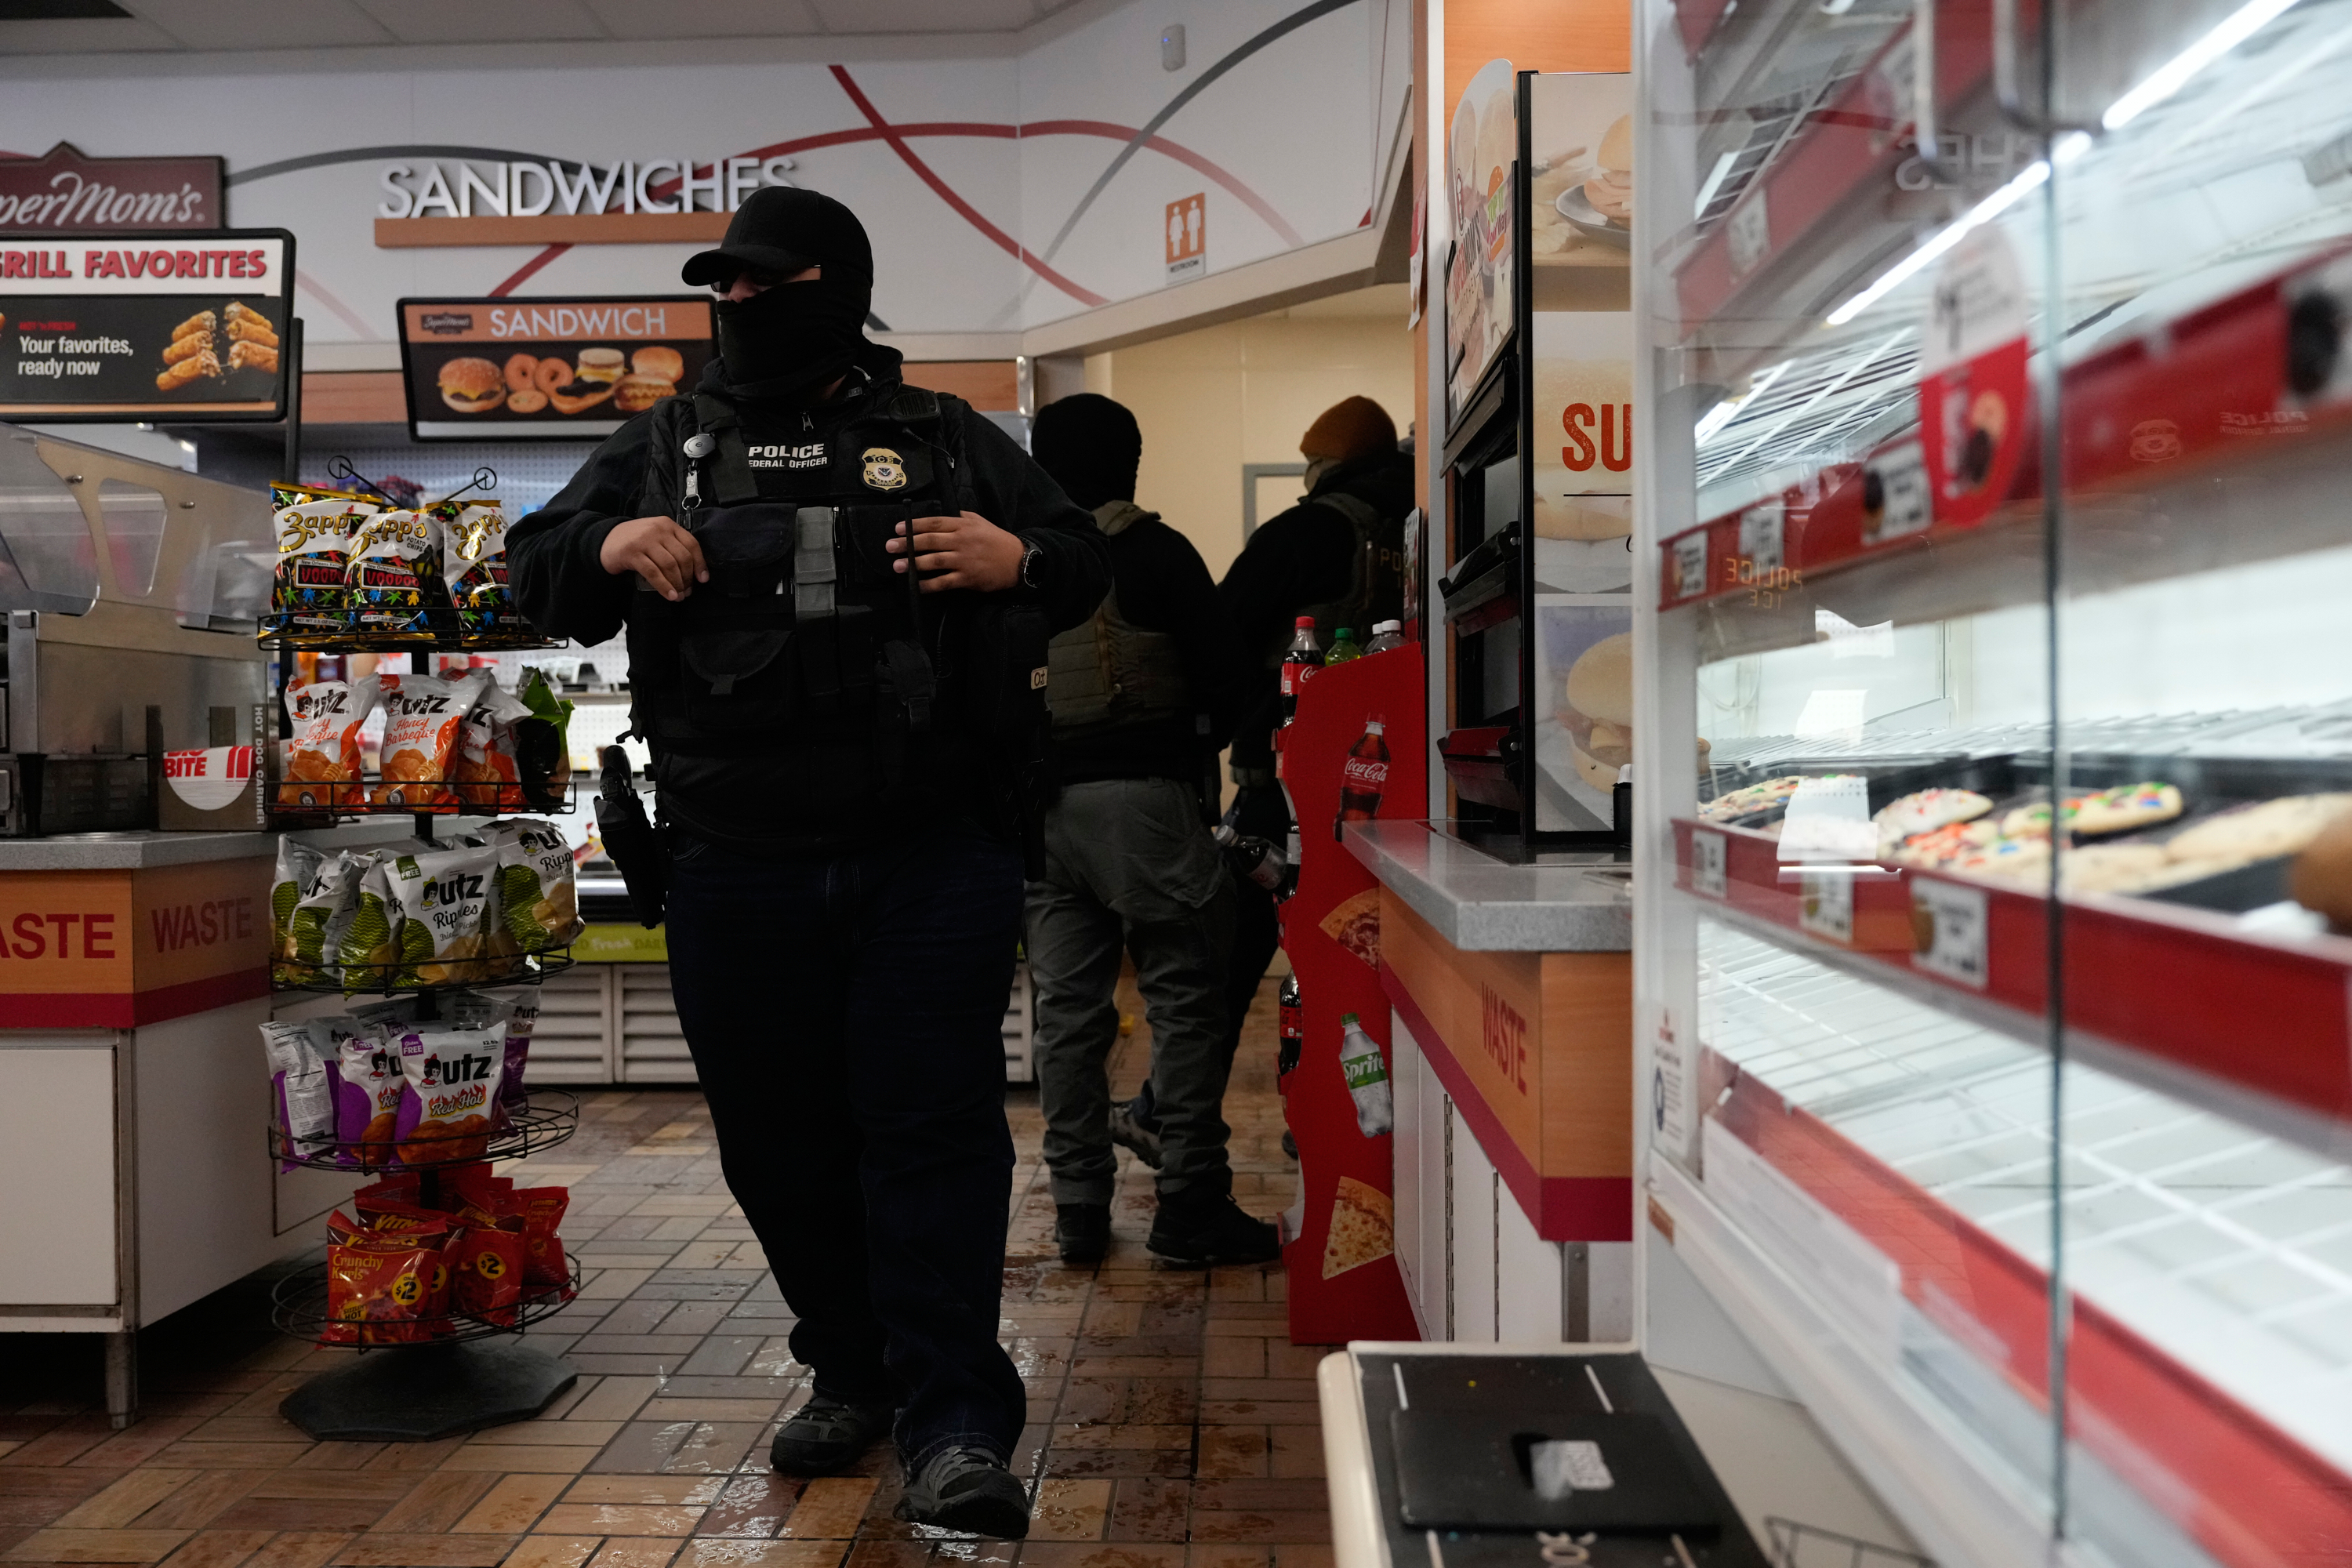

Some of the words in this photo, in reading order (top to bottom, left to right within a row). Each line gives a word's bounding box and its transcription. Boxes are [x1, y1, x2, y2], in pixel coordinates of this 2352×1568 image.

[0, 250, 71, 278] RILL
[84, 249, 267, 278] FAVORITES
[489, 308, 666, 338] SANDWICH
[19, 336, 56, 354] Your
[58, 336, 133, 357] favorites,
[18, 357, 64, 379] ready
[67, 361, 100, 375] now
[748, 443, 824, 459] POLICE
[789, 456, 828, 469] OFFICER
[406, 535, 426, 547] POTATO
[406, 542, 423, 553] CHIPS
[255, 706, 263, 733] HOT
[393, 717, 430, 731] Honey
[385, 728, 436, 747] Barbeque
[255, 738, 264, 764] DOG
[163, 757, 207, 778] BITE
[1345, 757, 1388, 782] Coca-Cola
[256, 770, 265, 824] CARRIER
[401, 868, 420, 880] FREE
[151, 898, 252, 953] WASTE
[0, 913, 115, 960] STE
[403, 1045, 423, 1054] FREE
[1482, 981, 1526, 1097] WASTE
[1344, 1054, 1385, 1083] Sprite
[432, 1098, 456, 1116] Red
[459, 1091, 484, 1109] Hot
[332, 1254, 383, 1271] Crunchy
[481, 1258, 499, 1275] $2
[396, 1281, 417, 1300] $2
[345, 1310, 361, 1320] HOT
